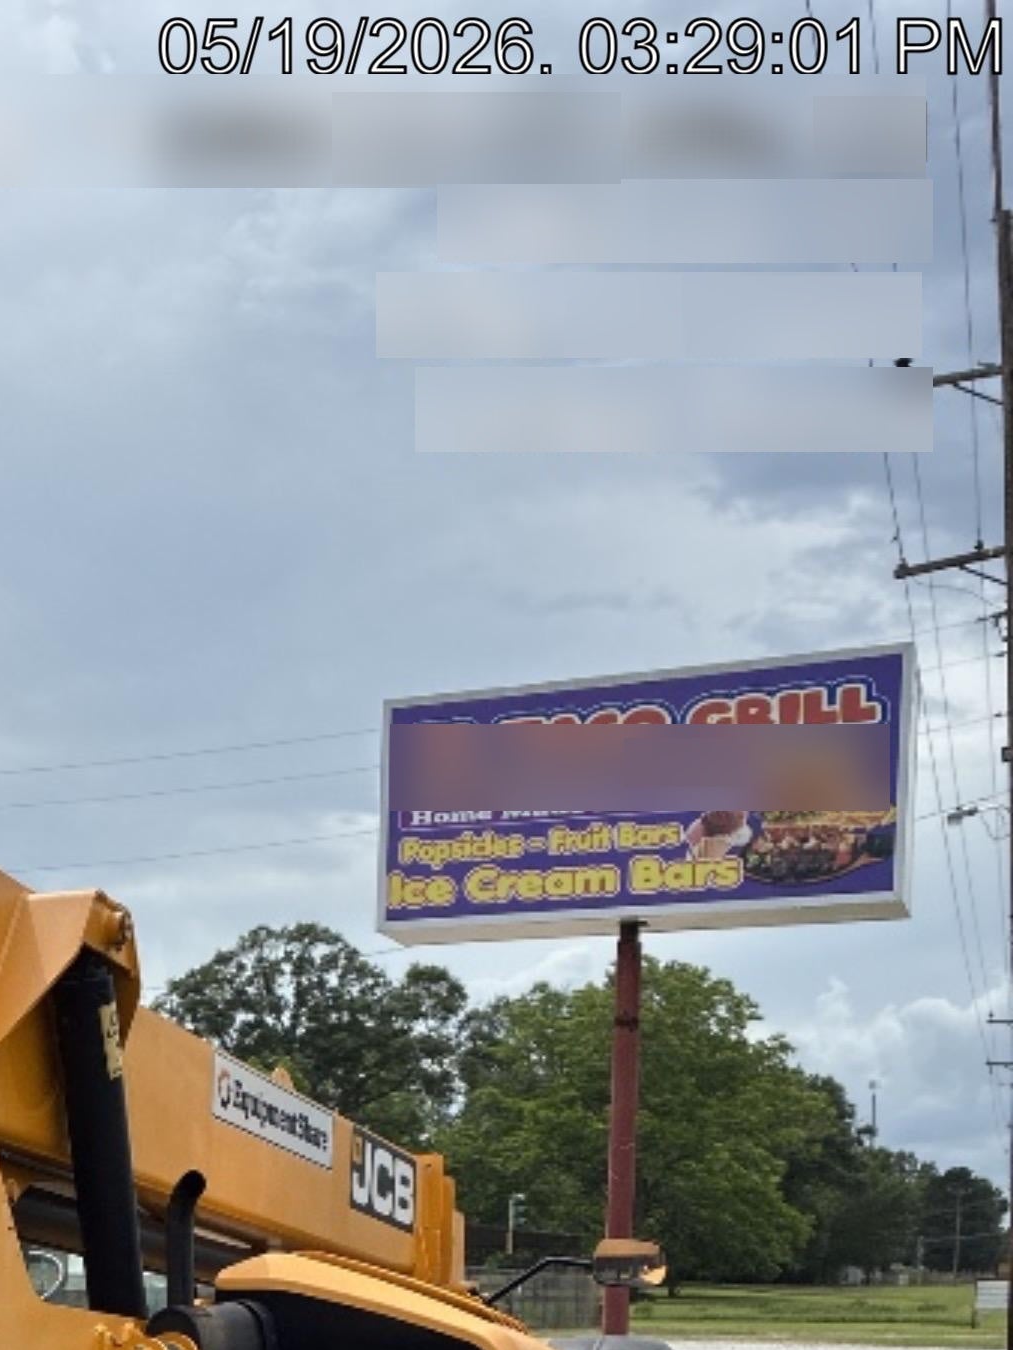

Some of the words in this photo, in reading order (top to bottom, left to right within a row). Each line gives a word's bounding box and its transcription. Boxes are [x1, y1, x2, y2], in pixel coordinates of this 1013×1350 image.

[686, 683, 882, 724] GRILL
[410, 811, 492, 826] Home
[399, 831, 525, 869] Popsicles
[548, 825, 613, 855] Fruit
[615, 822, 684, 852] Bars
[388, 870, 457, 909] Ice
[464, 864, 621, 903] Cream
[628, 855, 744, 895] Bars
[352, 1141, 415, 1226] JCB
